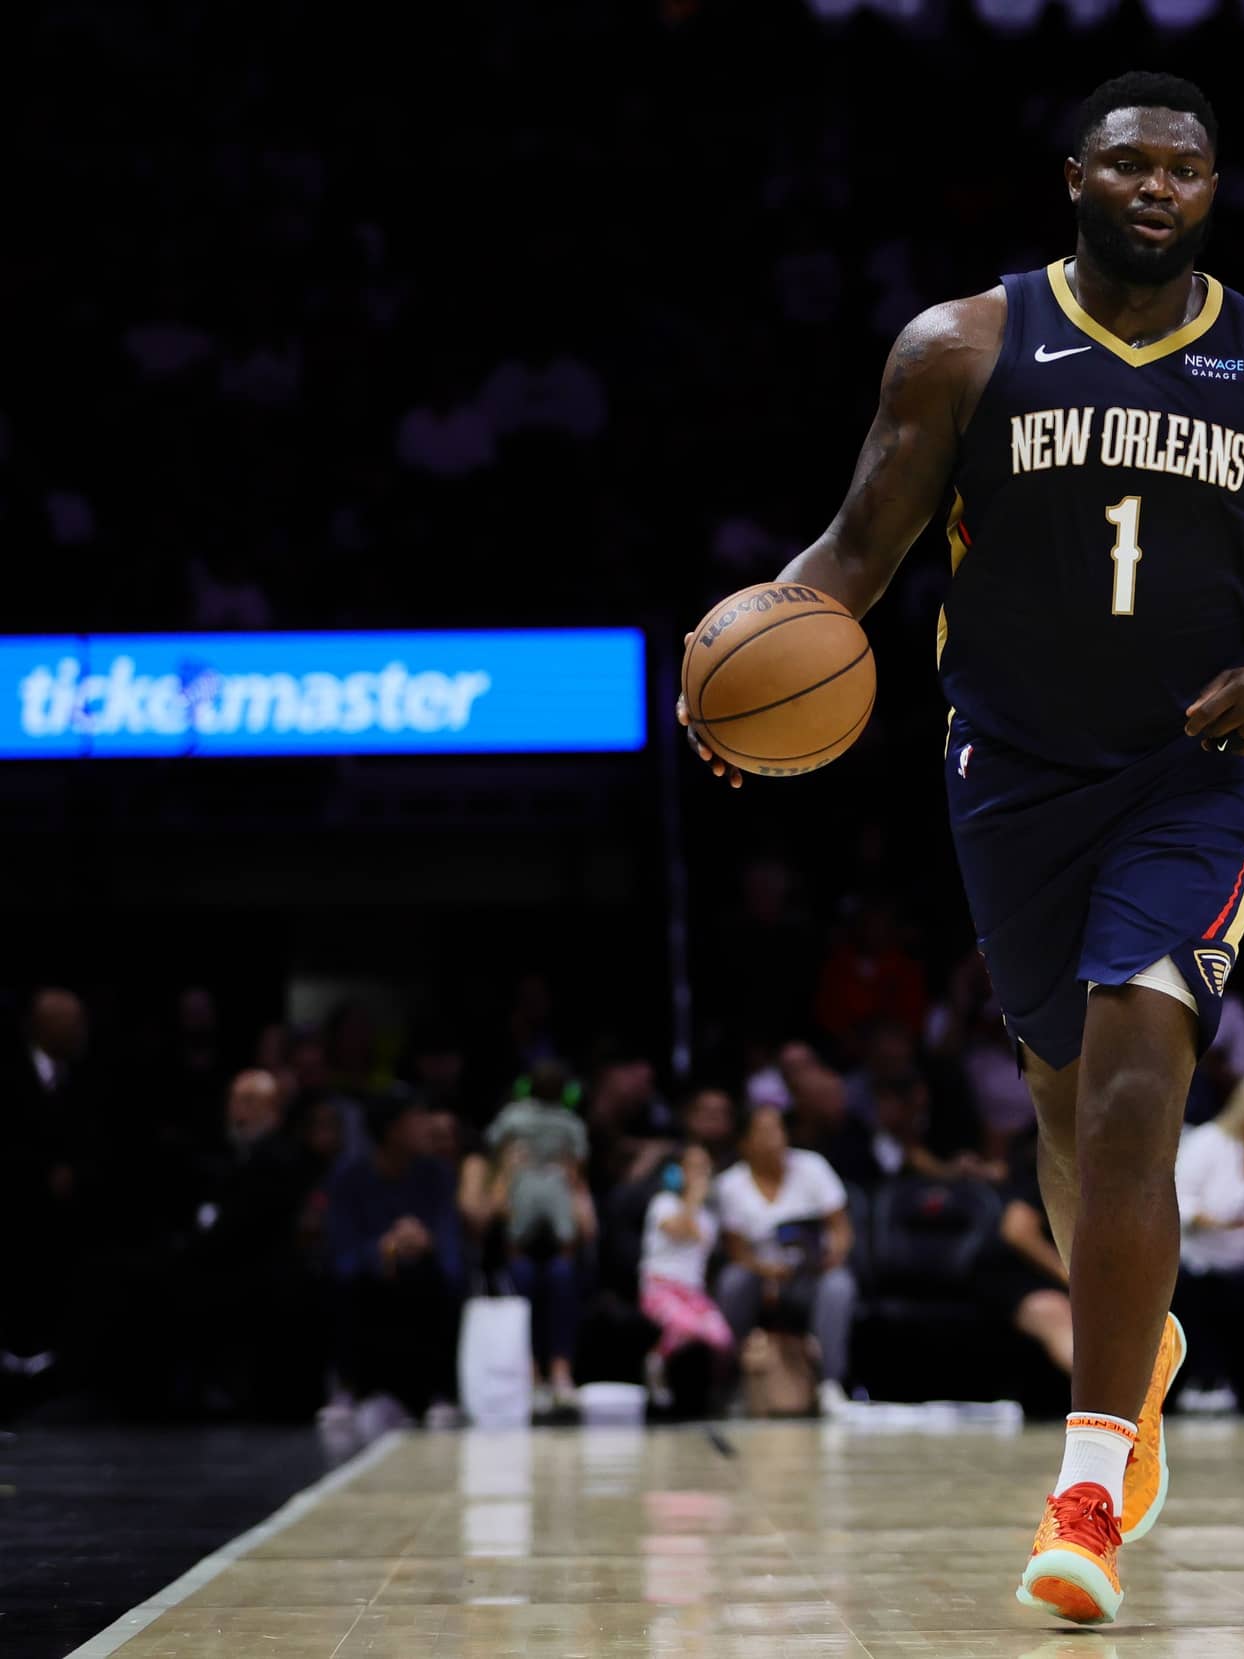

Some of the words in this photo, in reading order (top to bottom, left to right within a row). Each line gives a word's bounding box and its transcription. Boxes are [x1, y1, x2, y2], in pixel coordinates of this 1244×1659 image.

[1184, 353, 1244, 372] NEWAGE
[1191, 368, 1238, 381] GARAGE
[1010, 406, 1095, 474] NEW
[1105, 495, 1142, 615] 1
[700, 586, 825, 649] Wilson
